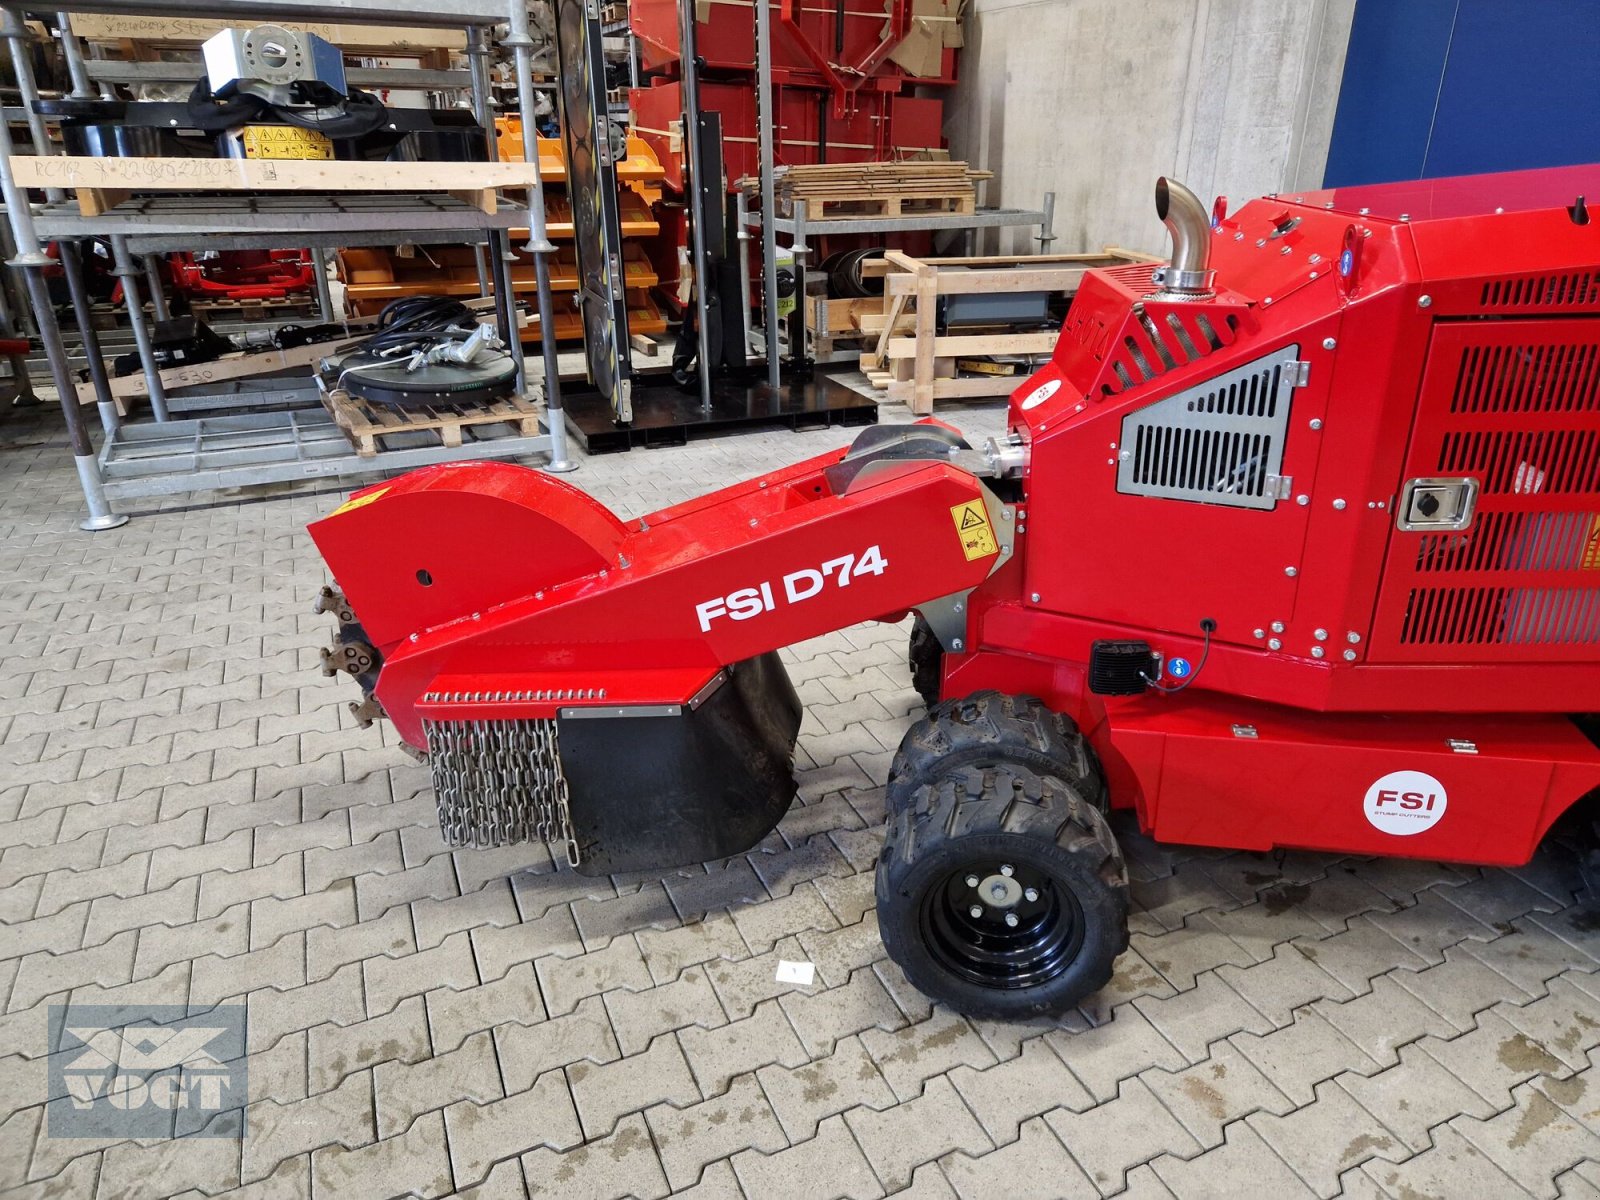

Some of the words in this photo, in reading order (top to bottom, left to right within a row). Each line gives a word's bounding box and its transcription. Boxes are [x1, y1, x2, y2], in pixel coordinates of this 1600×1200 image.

[695, 581, 776, 633] FSI
[782, 544, 889, 604] D74
[1376, 789, 1436, 811] FSI
